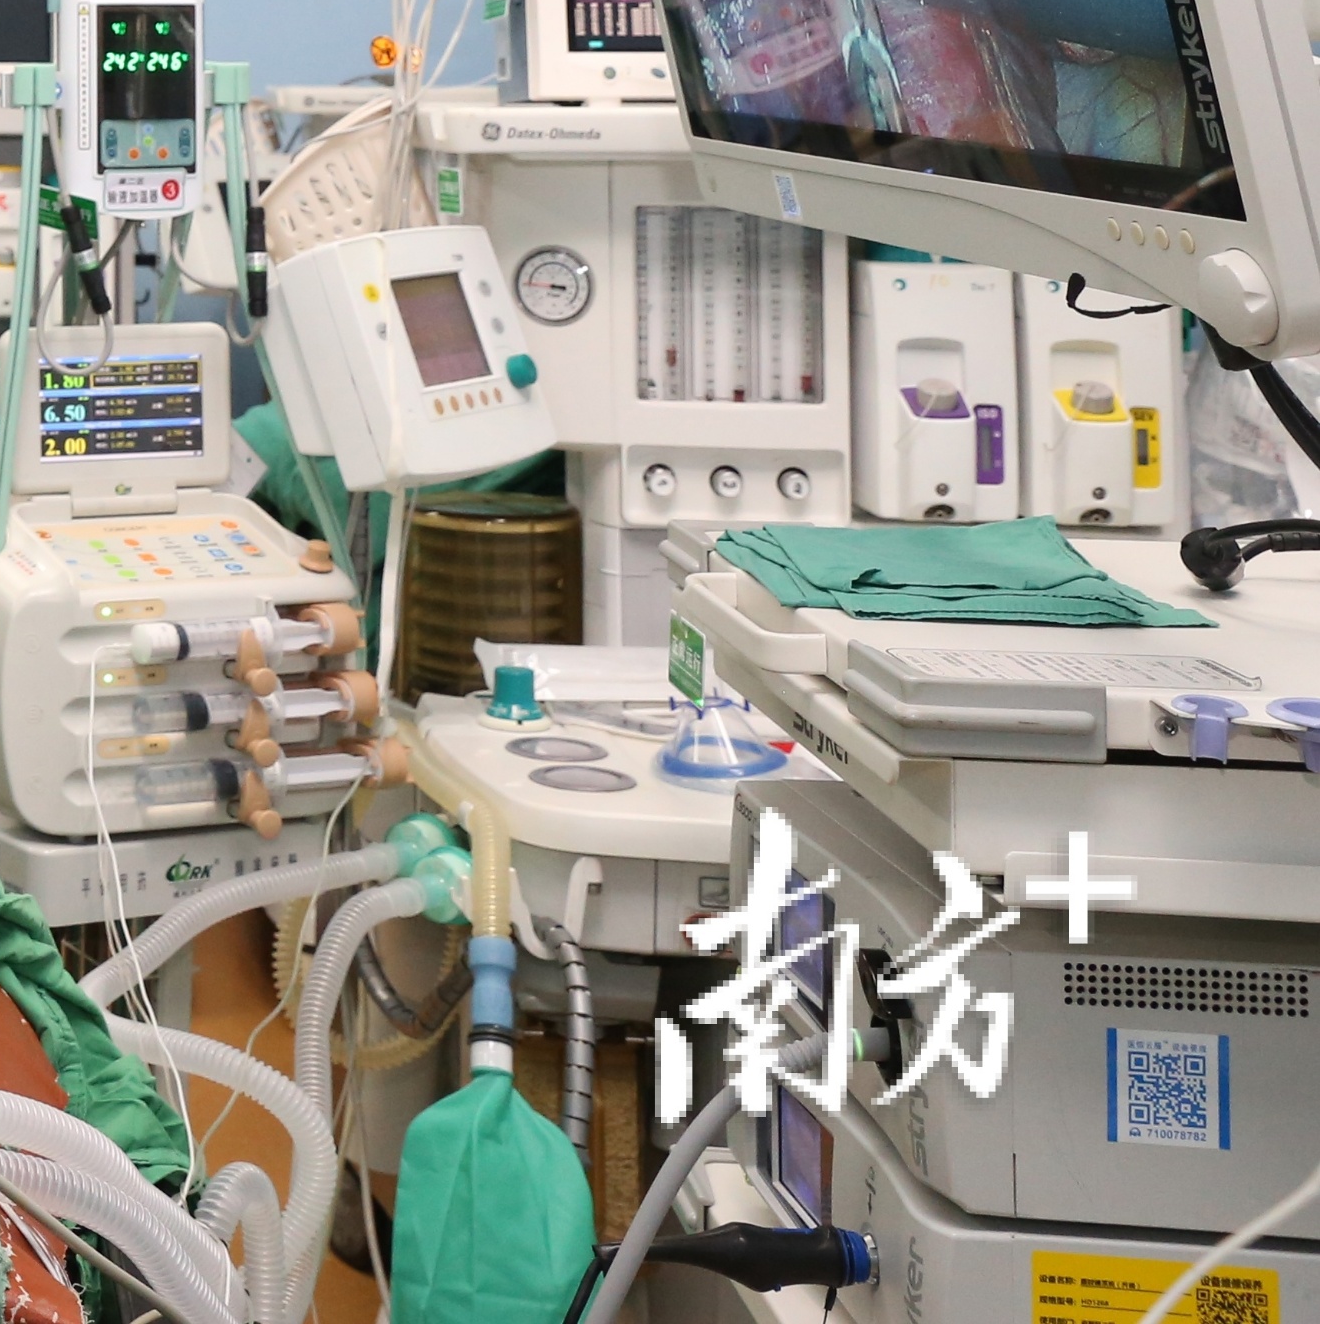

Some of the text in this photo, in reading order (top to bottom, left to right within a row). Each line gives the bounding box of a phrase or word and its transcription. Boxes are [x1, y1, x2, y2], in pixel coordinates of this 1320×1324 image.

[506, 127, 601, 140] Datex-Ohmeda
[44, 374, 84, 389] 1.80
[44, 405, 86, 422] 6.50
[45, 438, 86, 456] 2.00
[1147, 1129, 1207, 1141] 710078782
